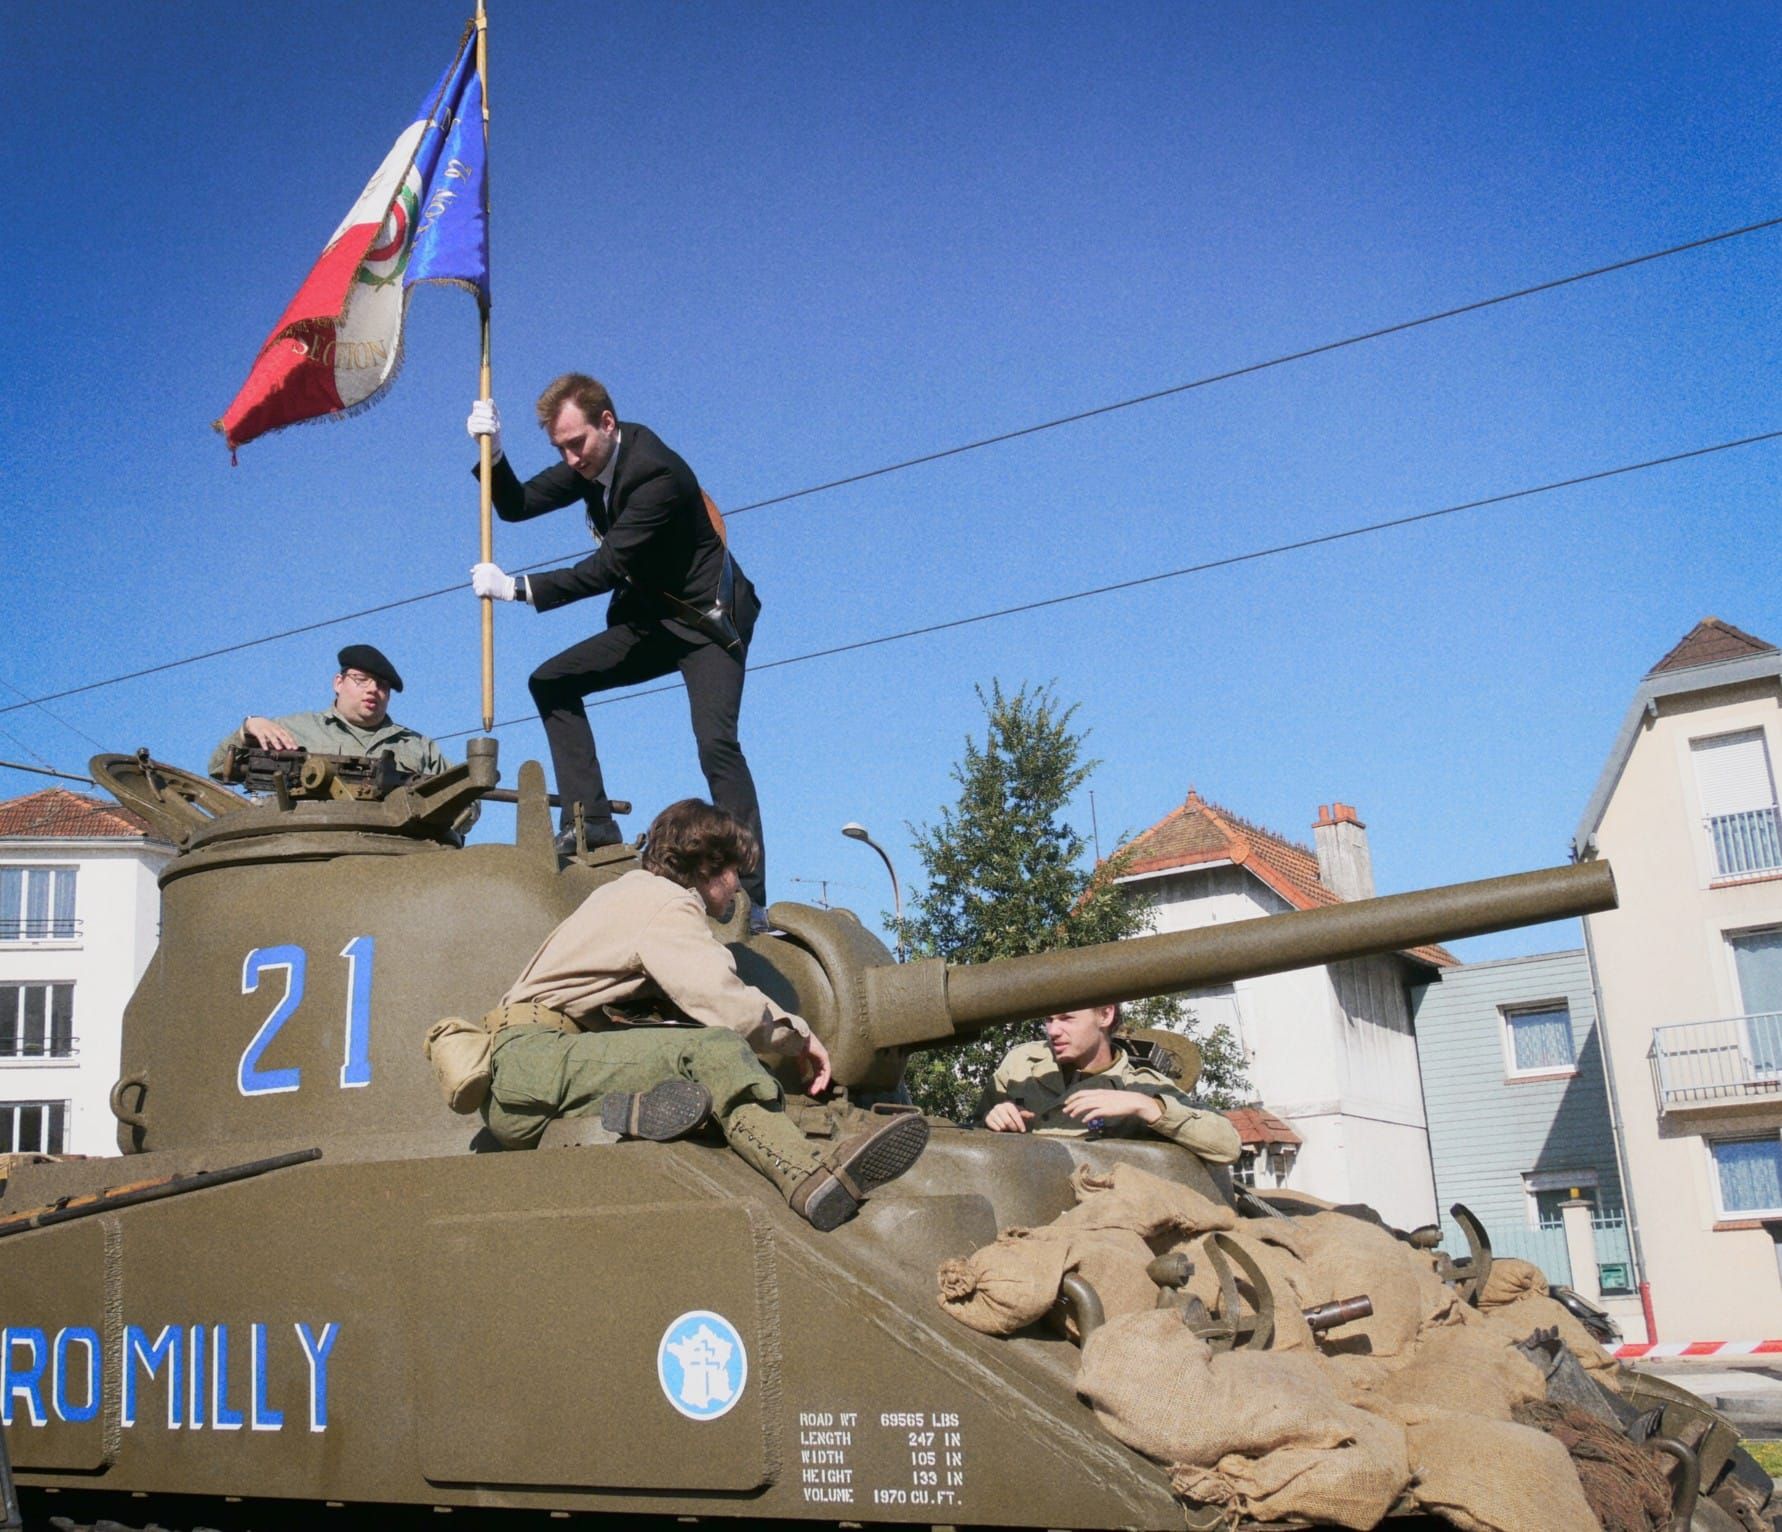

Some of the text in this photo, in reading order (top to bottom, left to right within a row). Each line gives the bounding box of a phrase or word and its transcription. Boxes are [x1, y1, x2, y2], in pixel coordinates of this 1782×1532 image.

[237, 934, 376, 1097] 21
[0, 1322, 341, 1432] ROMILLY
[799, 1412, 960, 1428] ROAD WT 69565 LBS
[800, 1431, 961, 1447] LENGTH 247 IN
[801, 1450, 963, 1466] WIDTH 105 IN
[802, 1469, 964, 1486] HEIGHT 133 IN
[803, 1487, 854, 1504] VOLUME
[873, 1489, 907, 1505] 1970
